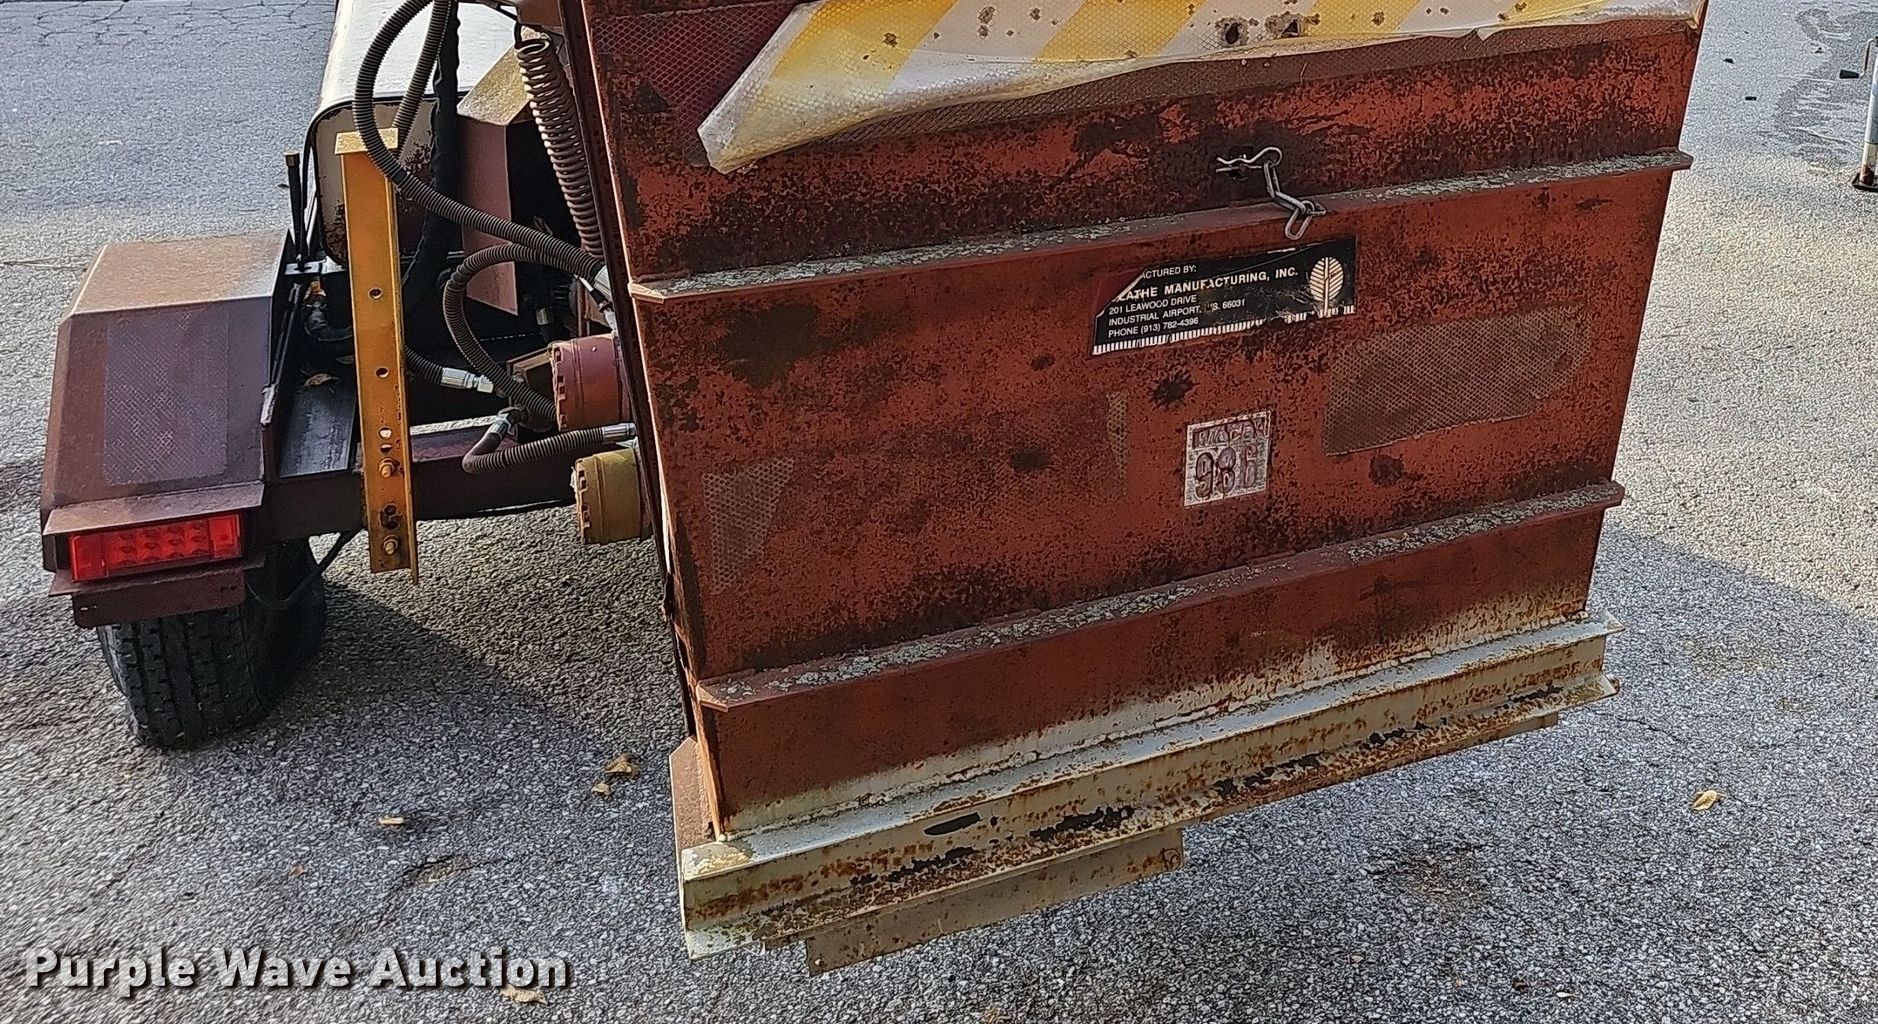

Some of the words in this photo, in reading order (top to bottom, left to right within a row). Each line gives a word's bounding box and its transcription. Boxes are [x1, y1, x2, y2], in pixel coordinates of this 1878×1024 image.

[1183, 264, 1197, 274] BY:
[1115, 287, 1158, 302] LATHE
[1164, 271, 1270, 295] MANUFACTURING,
[1275, 266, 1299, 279] INC.
[1108, 312, 1160, 327] INDUSTRIAL
[1222, 298, 1246, 310] 66031
[1109, 306, 1123, 315] 201
[1125, 299, 1169, 313] LEAWOOD
[1170, 294, 1197, 306] DRIVE
[1108, 326, 1139, 338] PHONE
[1140, 323, 1161, 335] (913)
[1162, 316, 1200, 330] 782-4396
